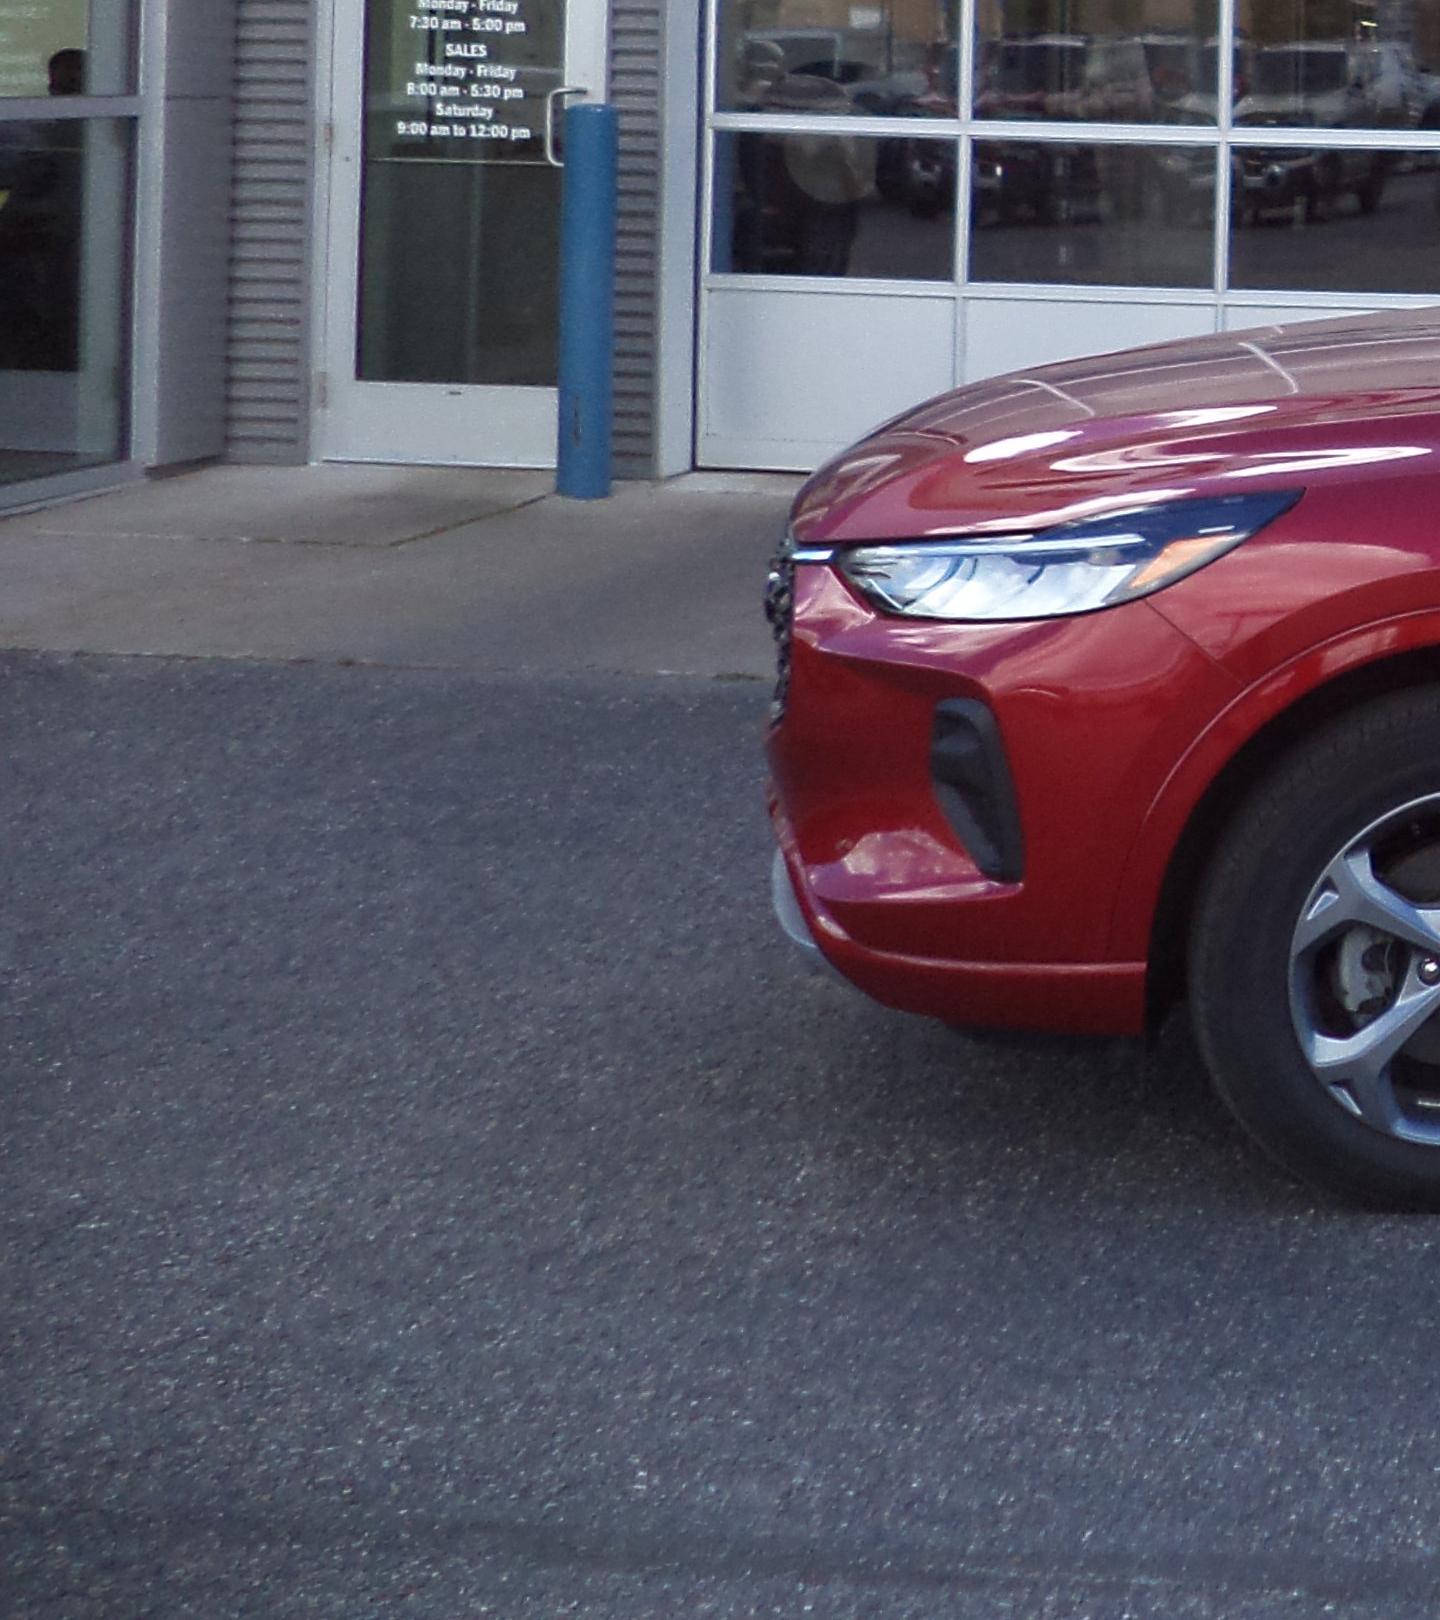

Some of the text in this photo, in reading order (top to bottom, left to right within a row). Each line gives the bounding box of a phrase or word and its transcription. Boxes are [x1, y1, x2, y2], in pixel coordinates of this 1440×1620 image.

[441, 21, 462, 31] am
[505, 21, 526, 35] pm
[445, 44, 487, 57] SALES
[415, 63, 467, 80] Monday
[477, 65, 517, 81] Friday
[440, 86, 460, 97] am
[503, 88, 524, 100] pm
[436, 103, 494, 121] Saturday
[430, 125, 450, 136] am
[453, 124, 466, 136] to
[470, 124, 508, 138] 12:00
[511, 128, 531, 140] pm
